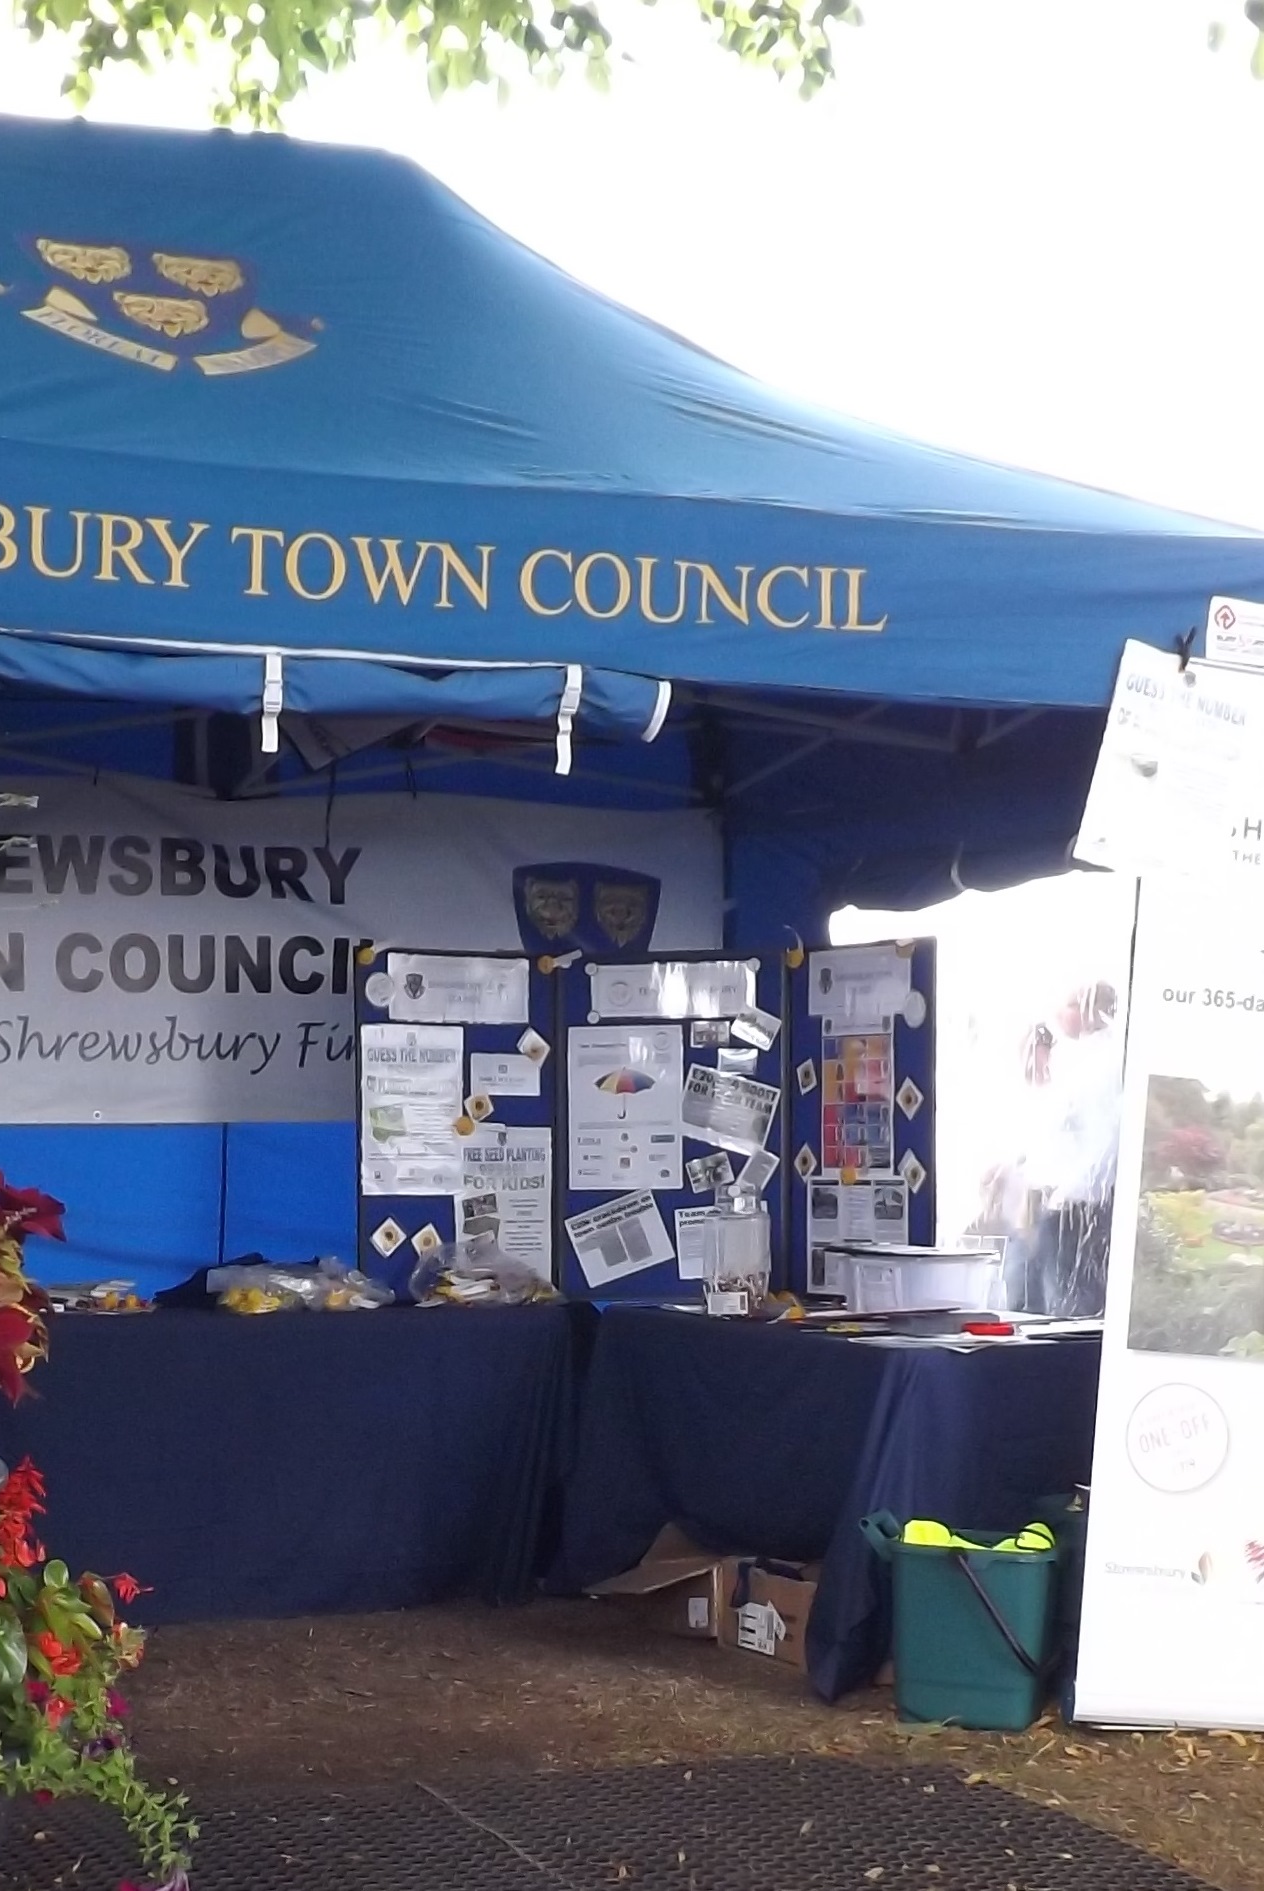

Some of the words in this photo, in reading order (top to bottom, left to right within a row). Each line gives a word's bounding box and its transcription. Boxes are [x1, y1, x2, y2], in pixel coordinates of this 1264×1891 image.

[230, 526, 496, 610] TOWN
[519, 548, 888, 633] COUNCIL
[1233, 850, 1262, 866] THE
[55, 932, 362, 994] COUNCI
[1163, 988, 1196, 1004] our
